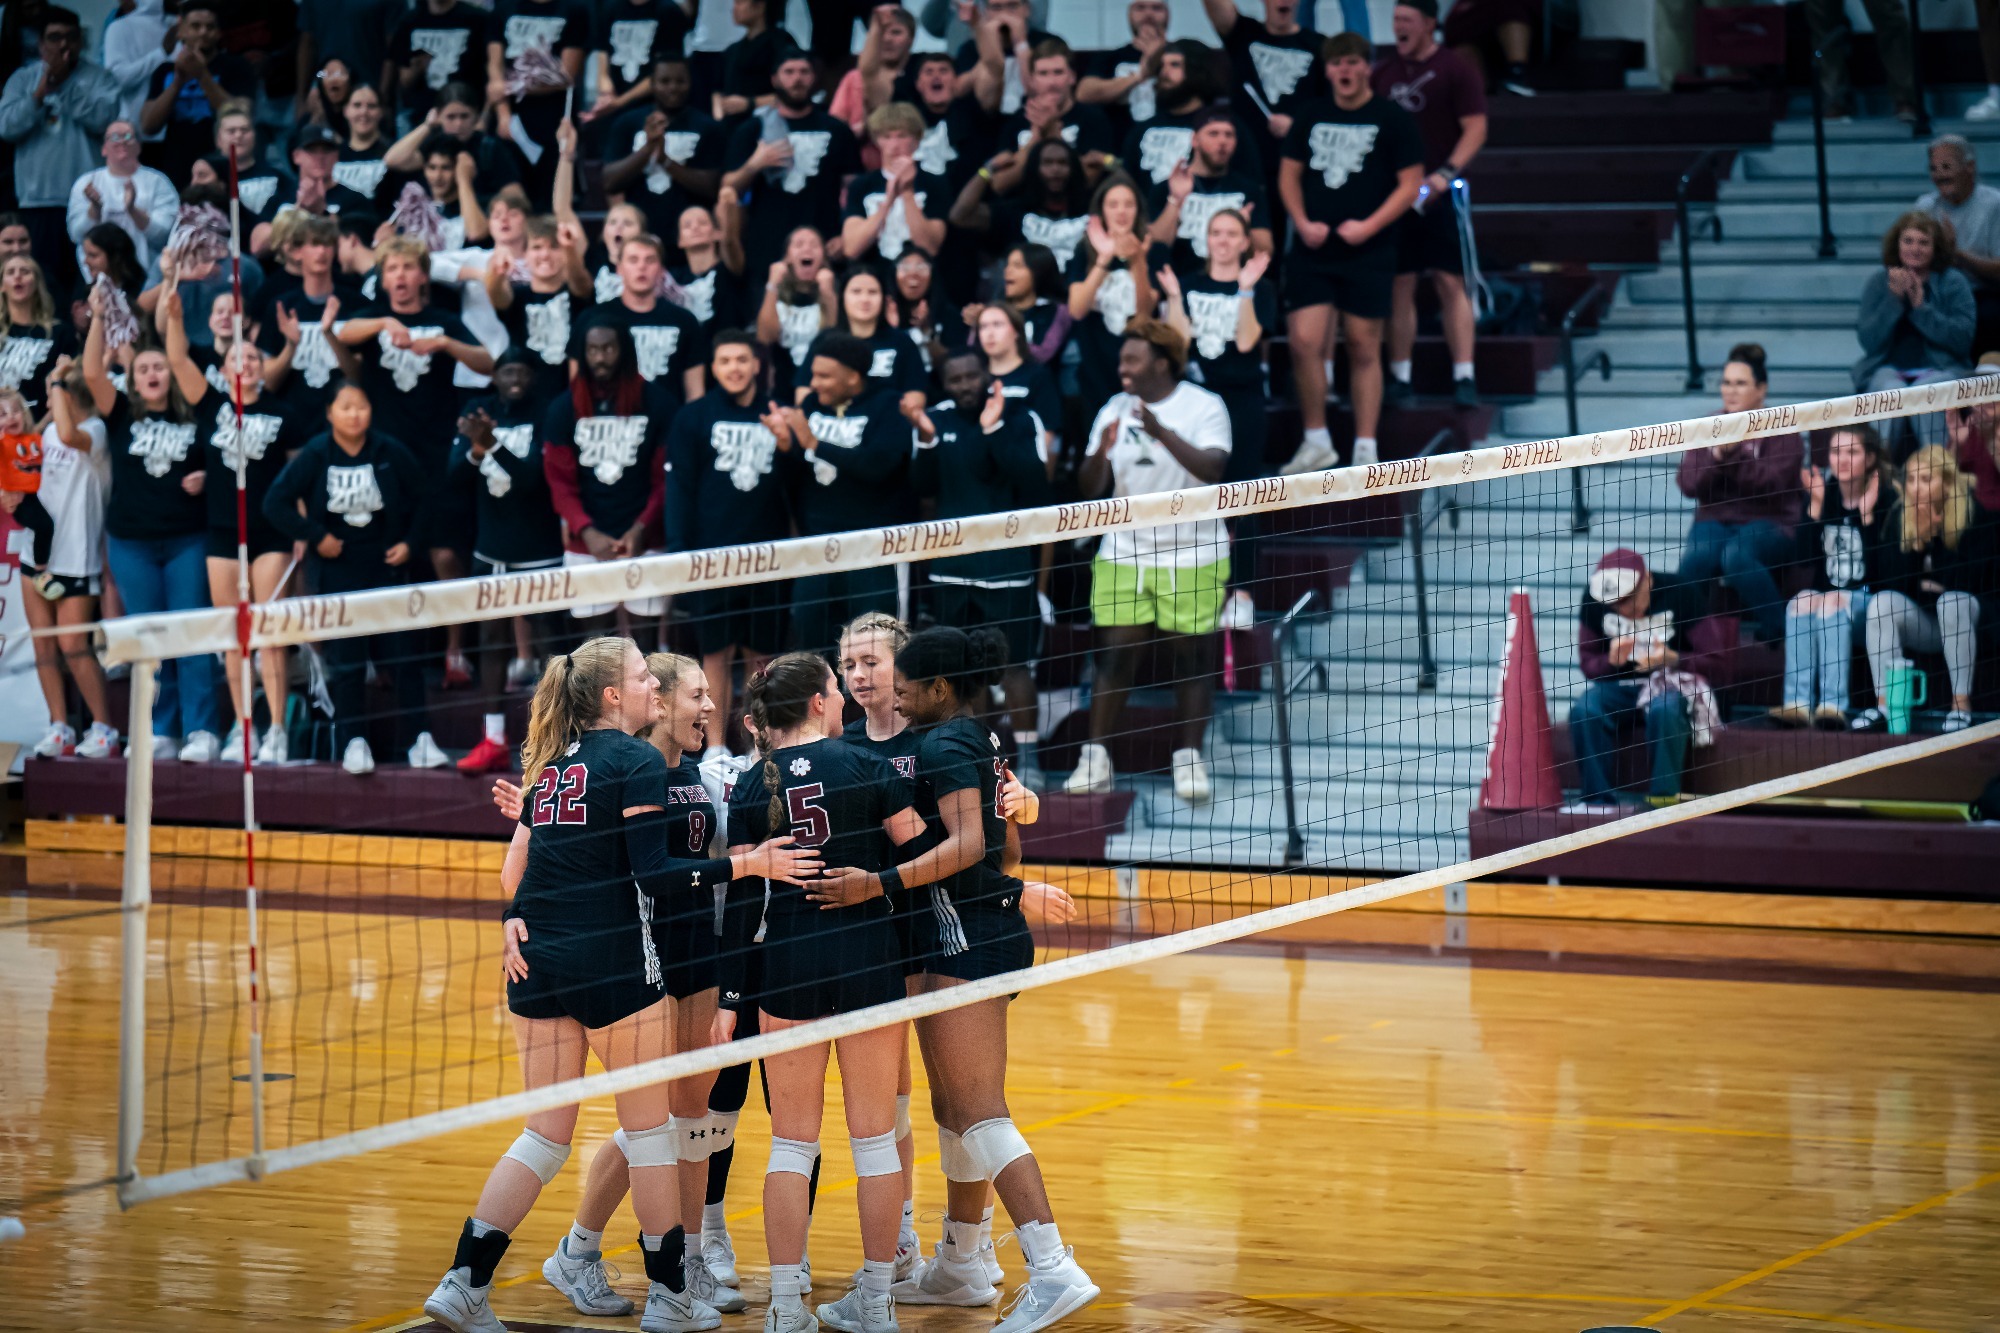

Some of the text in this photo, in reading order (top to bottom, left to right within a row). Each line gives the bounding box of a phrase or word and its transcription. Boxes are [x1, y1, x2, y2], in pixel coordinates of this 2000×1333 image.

[1746, 406, 1798, 433] BETHEL
[1854, 390, 1903, 417] BETHEL
[574, 416, 649, 447] STONE
[1629, 423, 1685, 452] BETHEL
[579, 442, 638, 467] ZONE
[714, 446, 773, 474] ZONE
[1502, 440, 1563, 469] BETHEL
[1364, 458, 1432, 489] BETHEL
[1217, 477, 1288, 510] BETHEL
[1055, 499, 1133, 533] BETHEL
[881, 520, 963, 556] BETHEL
[687, 543, 781, 582] BETHEL
[476, 570, 577, 610] BETHEL
[258, 597, 353, 635] ETHEL
[533, 763, 588, 826] 22
[688, 811, 706, 852] 8
[786, 782, 831, 848] 5
